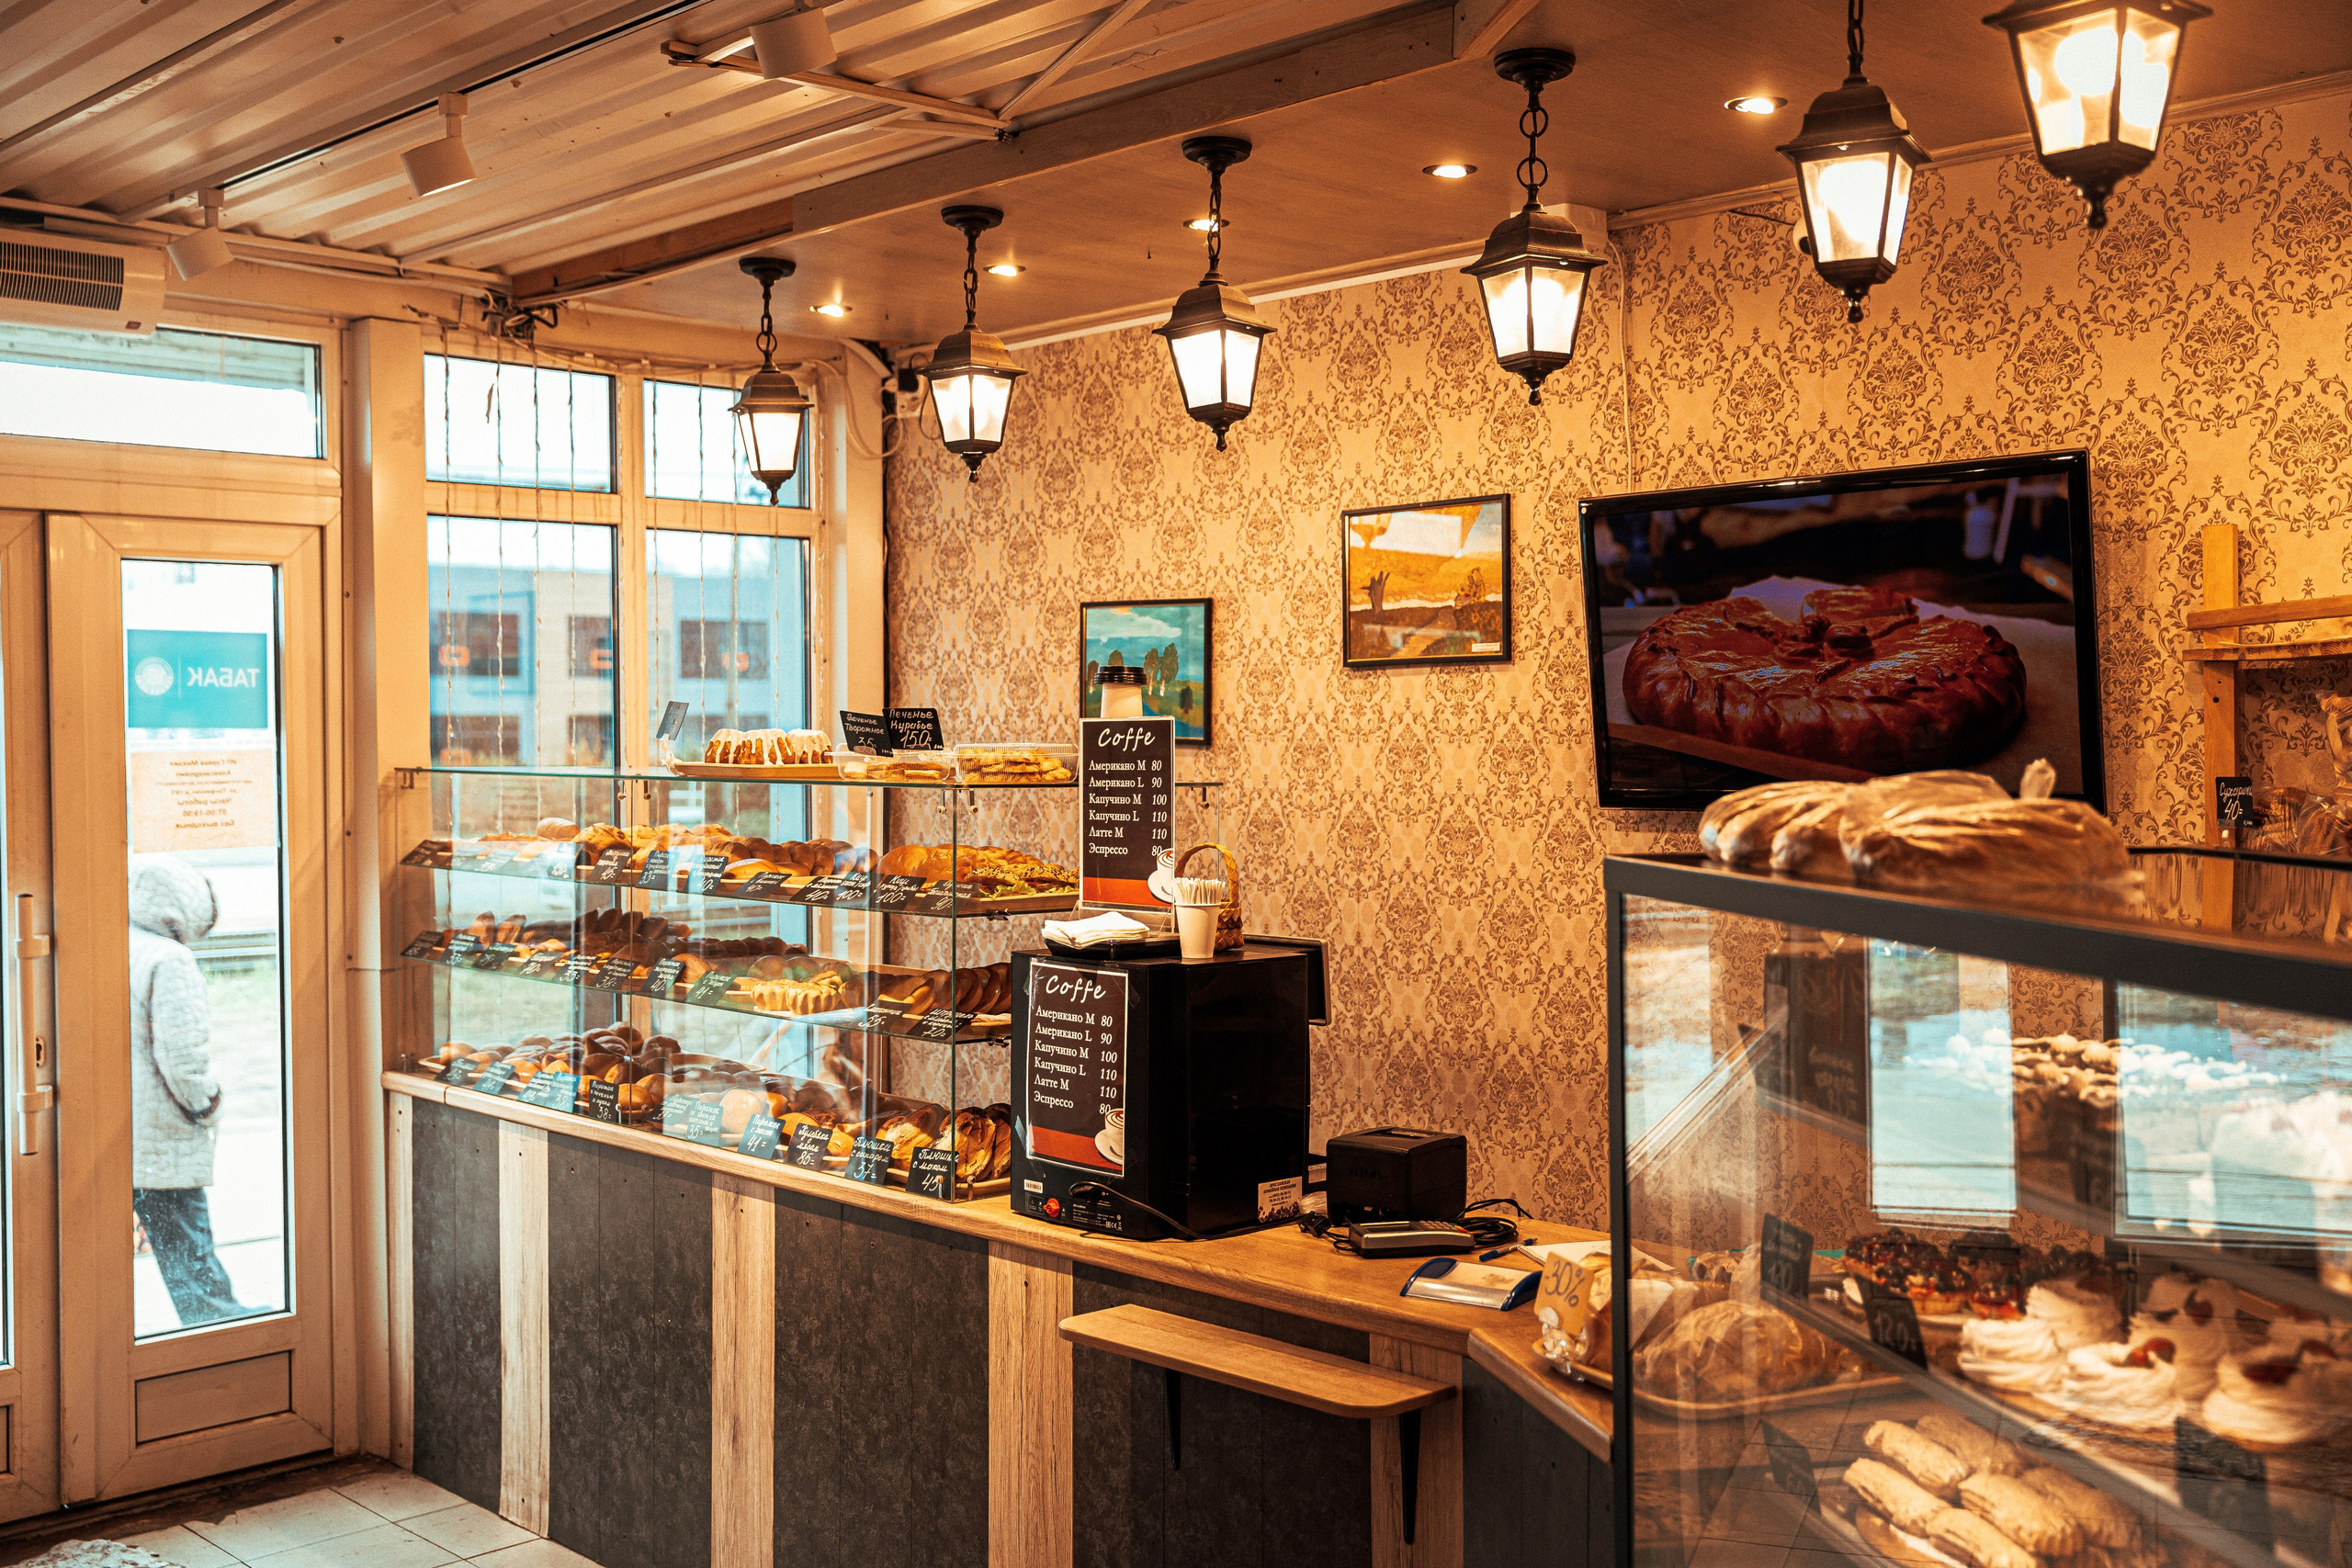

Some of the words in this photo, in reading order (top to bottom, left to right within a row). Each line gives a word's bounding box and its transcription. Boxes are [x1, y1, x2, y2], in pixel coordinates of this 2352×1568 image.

[889, 708, 933, 719] Печенье
[890, 720, 933, 733] Курабье
[1098, 727, 1156, 751] Coffe
[1089, 760, 1135, 773] Американо
[1151, 760, 1162, 772] 80
[1089, 777, 1136, 790] Американо
[1151, 777, 1162, 788] 90
[1089, 794, 1130, 807] Капучино
[1152, 795, 1167, 806] 100
[1089, 810, 1130, 823] Капучино
[1152, 811, 1167, 823] 110
[1089, 827, 1113, 838] Латте
[1152, 829, 1167, 840] 110
[1089, 843, 1128, 857] Эспрессо
[1151, 845, 1162, 857] 80
[1046, 975, 1106, 1003] Coffe
[1035, 1006, 1083, 1023] Американо
[1101, 1015, 1113, 1028] 80
[1035, 1023, 1083, 1041] Американо
[1101, 1033, 1113, 1045] 90
[1035, 1040, 1078, 1059] Капучино
[1101, 1051, 1117, 1064] 100
[1035, 1056, 1077, 1077] Капучино
[1100, 1068, 1117, 1081] 110
[1034, 1074, 1058, 1089] Латте
[1100, 1086, 1117, 1099] 110
[1034, 1090, 1074, 1109] Эспрессо
[1099, 1104, 1111, 1115] 80
[752, 1114, 781, 1130] Пирожок
[798, 1124, 830, 1141] Кулебяка
[919, 1162, 948, 1172] маком
